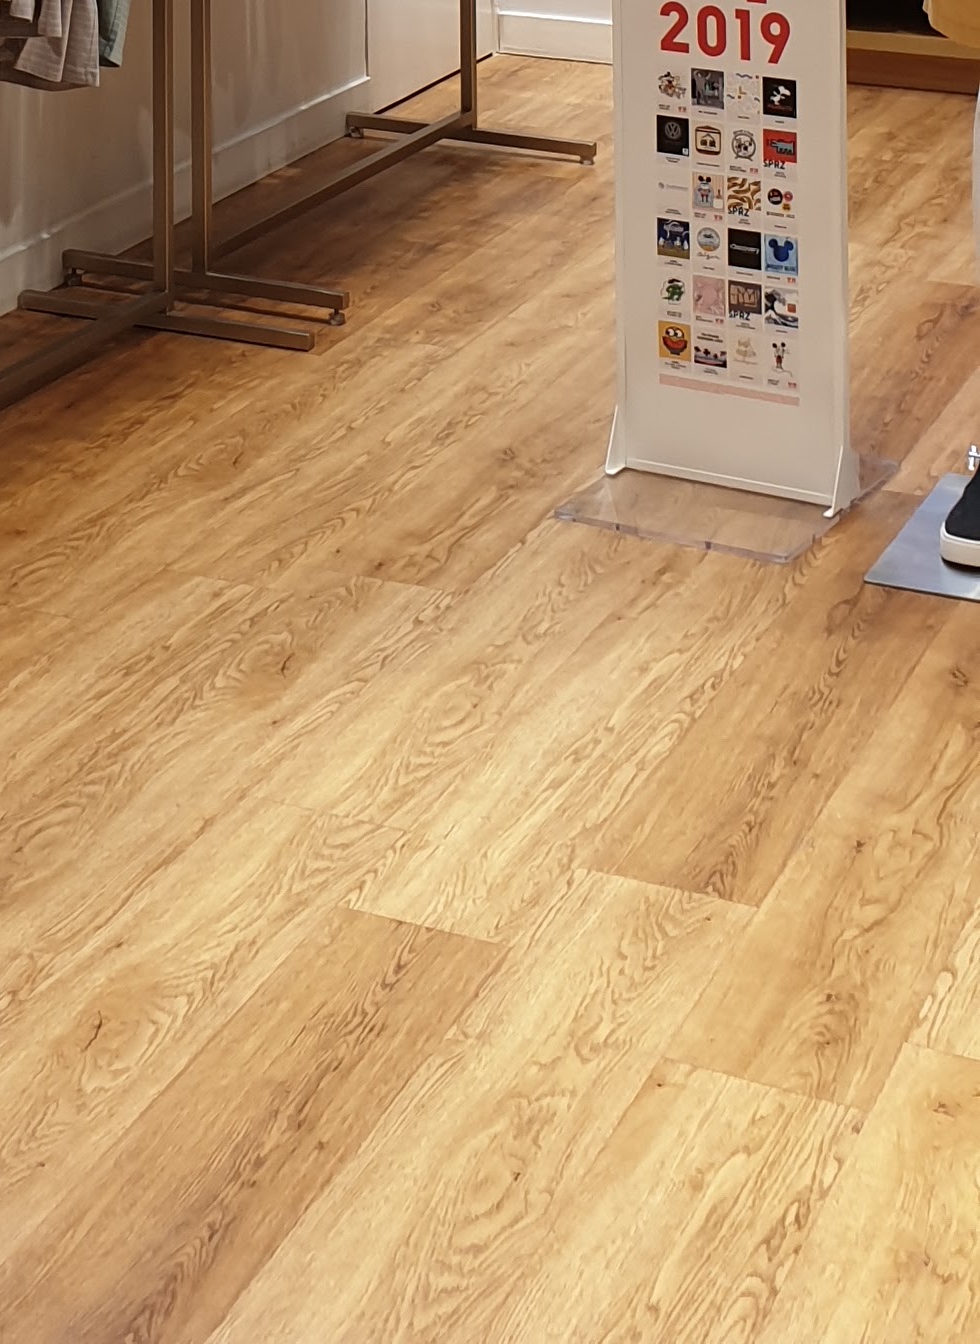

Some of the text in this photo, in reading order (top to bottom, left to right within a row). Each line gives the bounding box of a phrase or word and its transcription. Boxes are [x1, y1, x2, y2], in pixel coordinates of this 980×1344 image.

[659, 1, 791, 64] 2019
[763, 159, 786, 170] SPRZ
[727, 206, 750, 217] SPRZ
